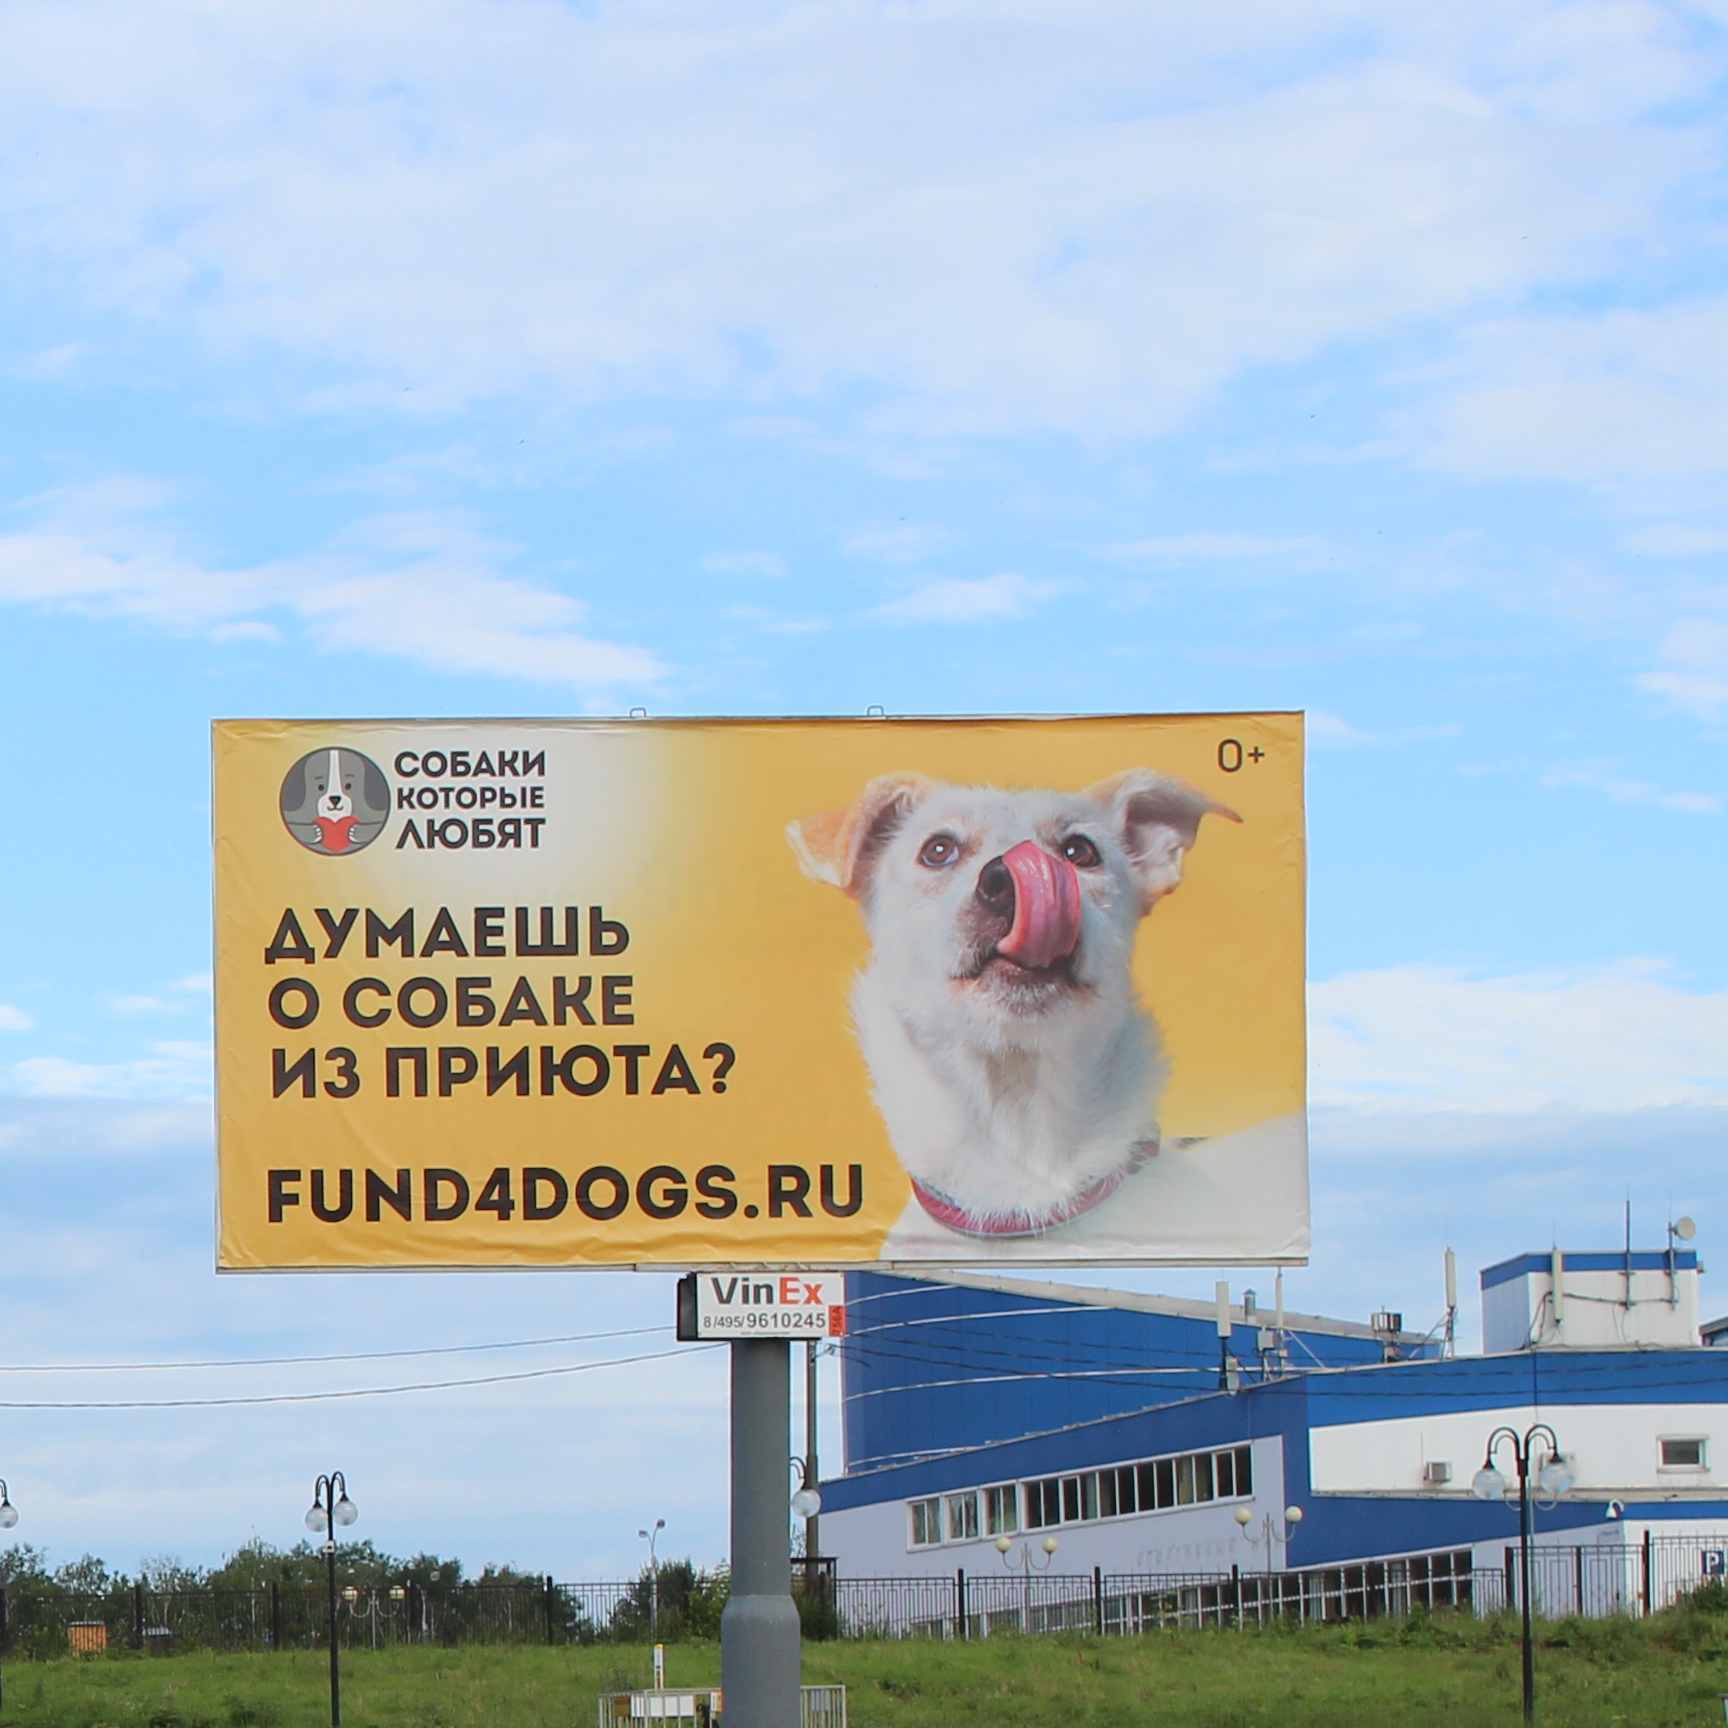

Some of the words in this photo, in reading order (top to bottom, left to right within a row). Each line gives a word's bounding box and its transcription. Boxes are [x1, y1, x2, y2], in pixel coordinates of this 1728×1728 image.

[394, 750, 546, 778] СОБАКИ
[1217, 739, 1265, 773] 0+
[397, 787, 545, 811] КОТОРЫЕ
[395, 817, 546, 850] ЛЮБЯТ
[264, 906, 630, 965] ДУМАЕШЬ
[268, 977, 320, 1030] О
[342, 975, 635, 1030] СОБАКЕ
[271, 1047, 361, 1099] ИЗ
[385, 1042, 737, 1098] ПРИЮТА?
[267, 1163, 863, 1224] FUND4DOGS.RU
[711, 1276, 824, 1306] VinEx
[1706, 1552, 1720, 1573] P
